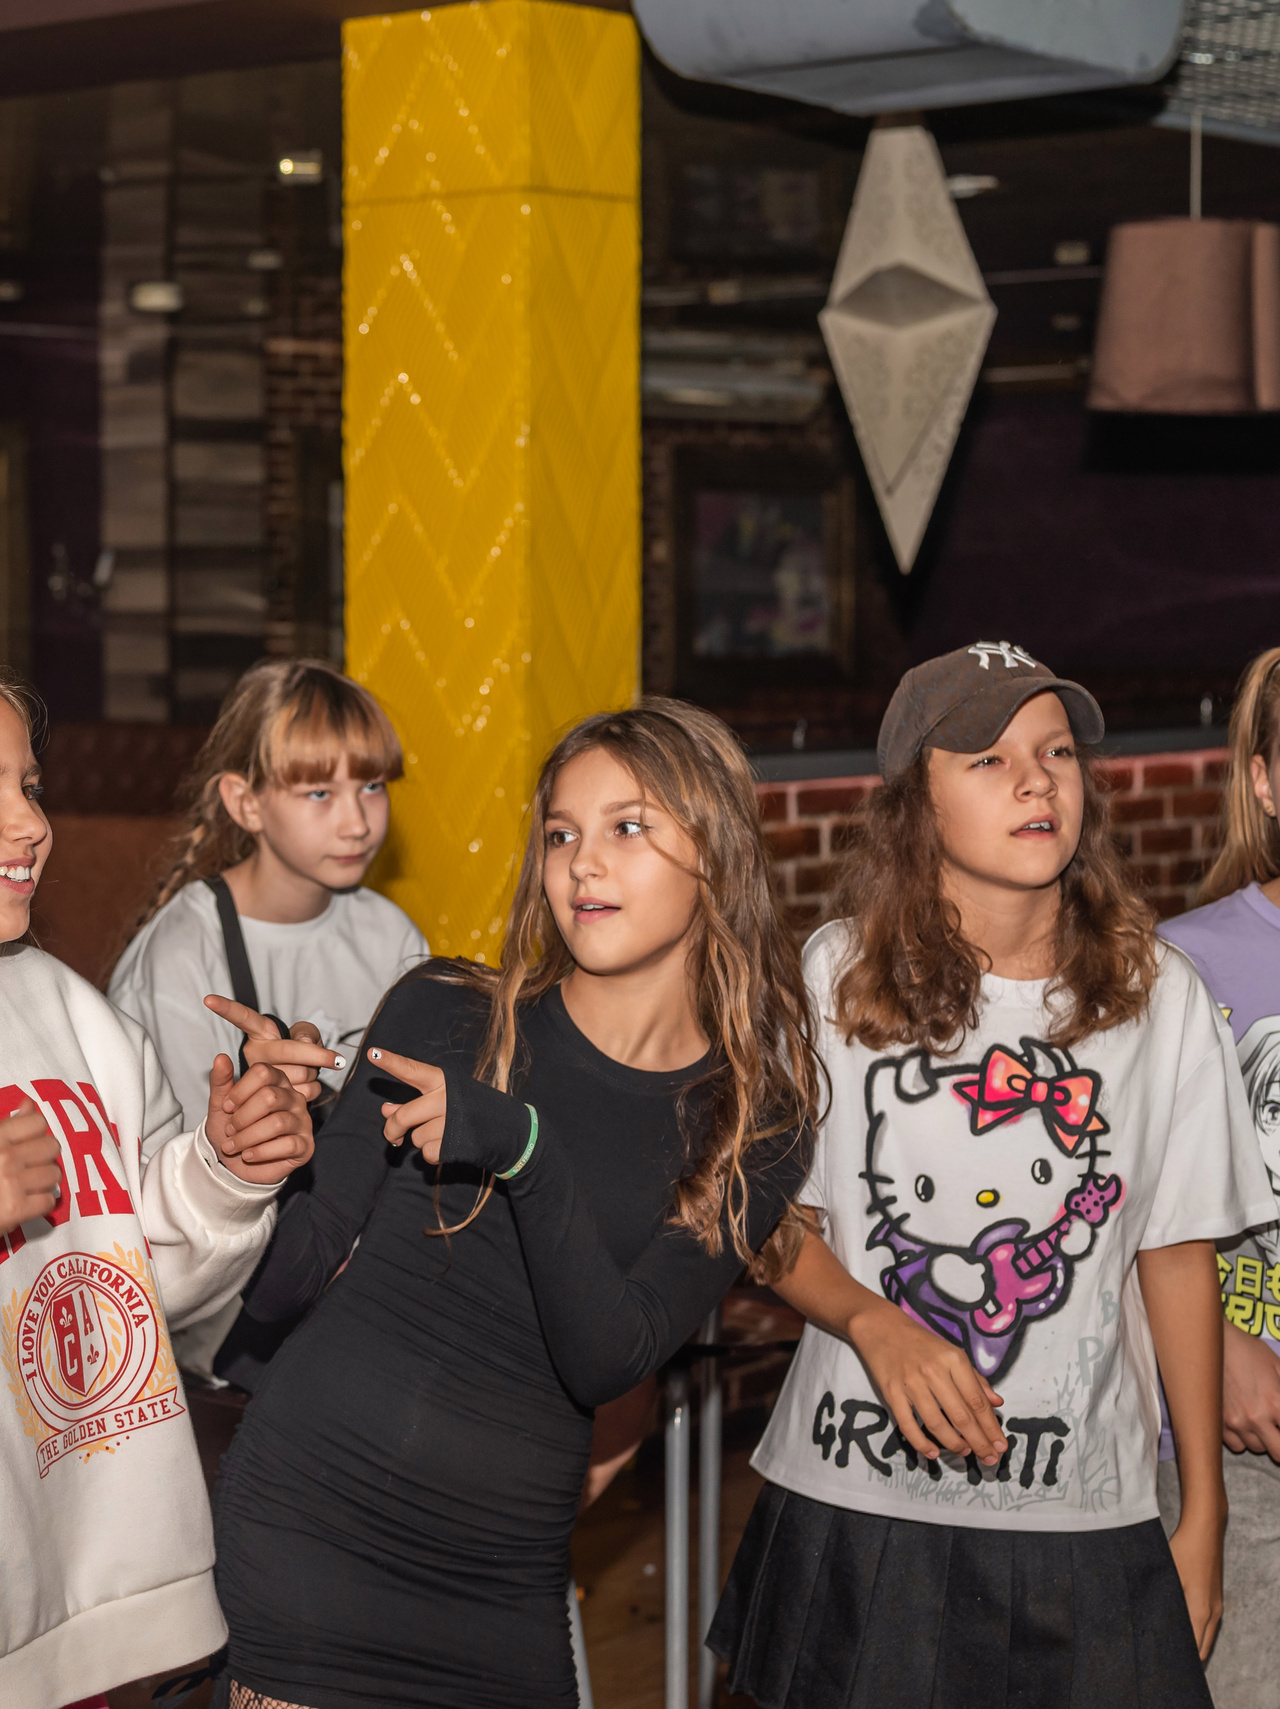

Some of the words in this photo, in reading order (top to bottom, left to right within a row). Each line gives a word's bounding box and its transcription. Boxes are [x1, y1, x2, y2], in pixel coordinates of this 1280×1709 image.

[33, 1270, 56, 1307] YOU
[56, 1258, 150, 1329] CALIFORNIA
[22, 1309, 39, 1366] LOVE
[26, 1369, 37, 1382] I
[40, 1439, 60, 1464] THE
[62, 1417, 108, 1450] GOLDEN
[114, 1398, 172, 1429] STATE
